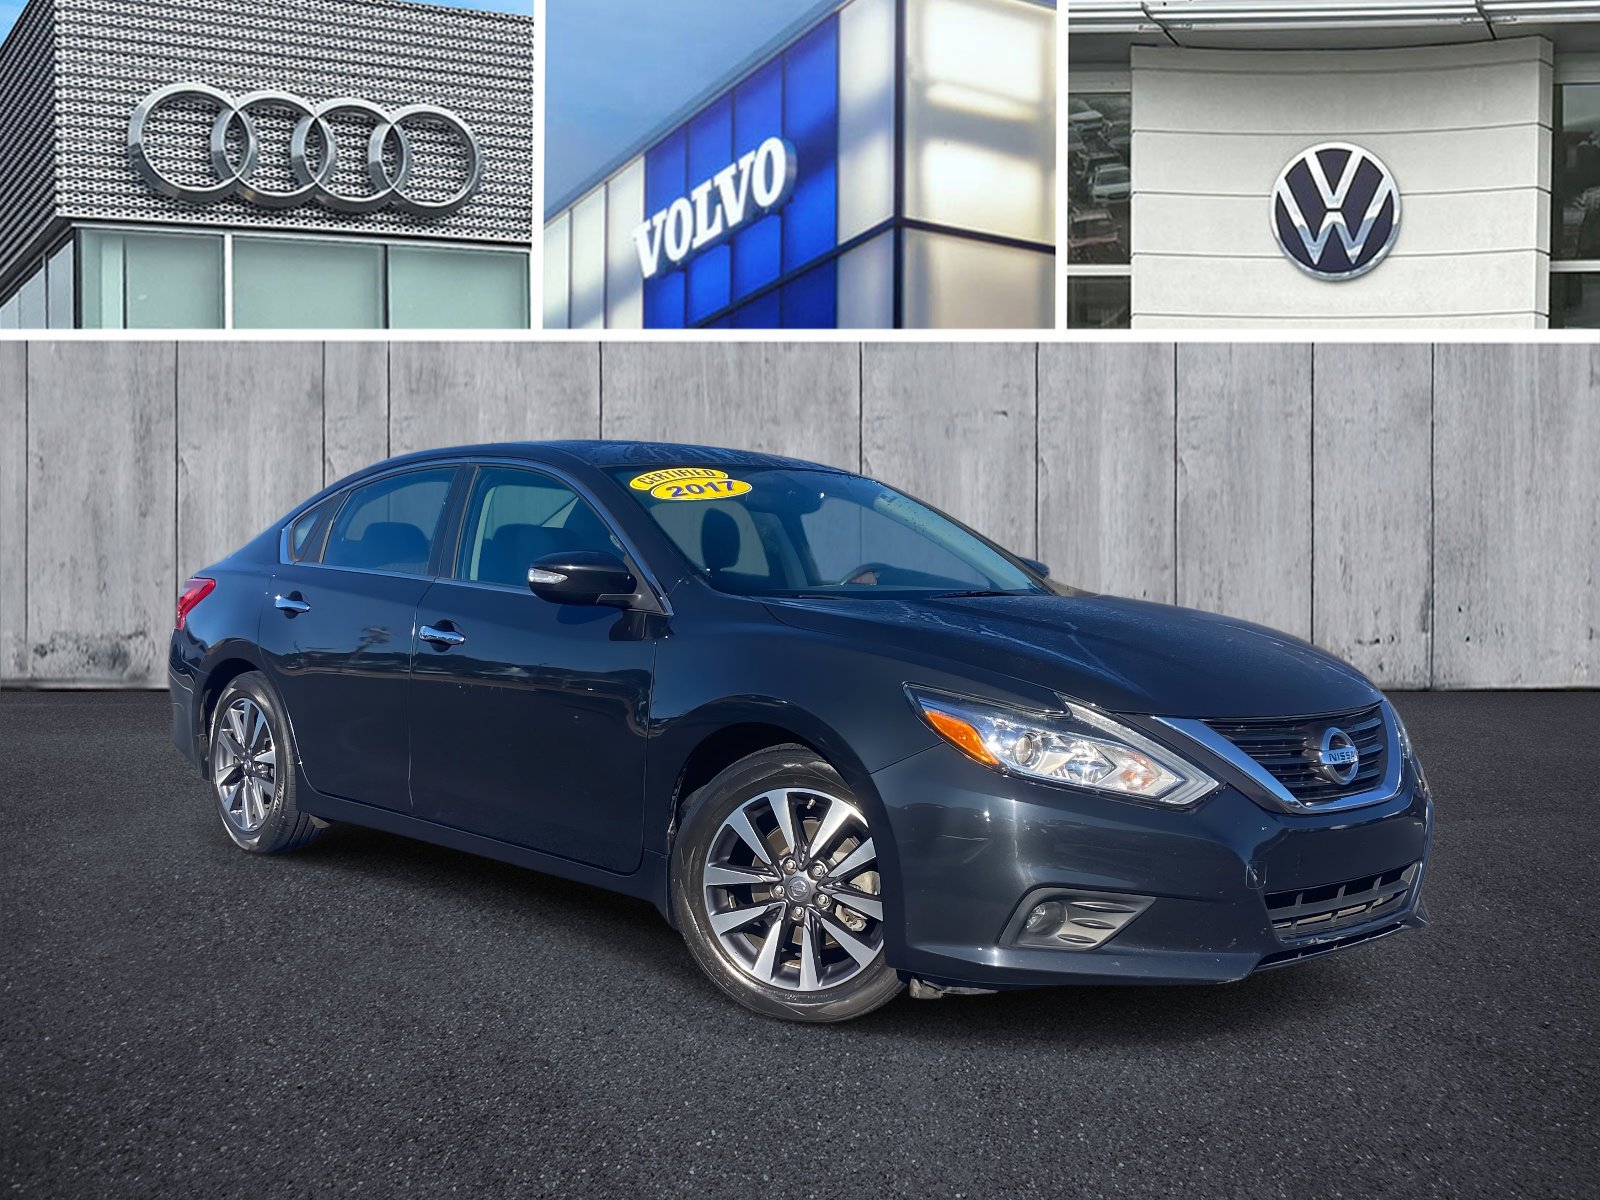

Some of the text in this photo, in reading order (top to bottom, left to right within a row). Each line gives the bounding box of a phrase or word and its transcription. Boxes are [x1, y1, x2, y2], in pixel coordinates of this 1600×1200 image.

[632, 137, 788, 279] VOLVO
[637, 468, 714, 485] CERTIFIED
[665, 480, 735, 498] 2017
[1328, 750, 1357, 762] NISSA
